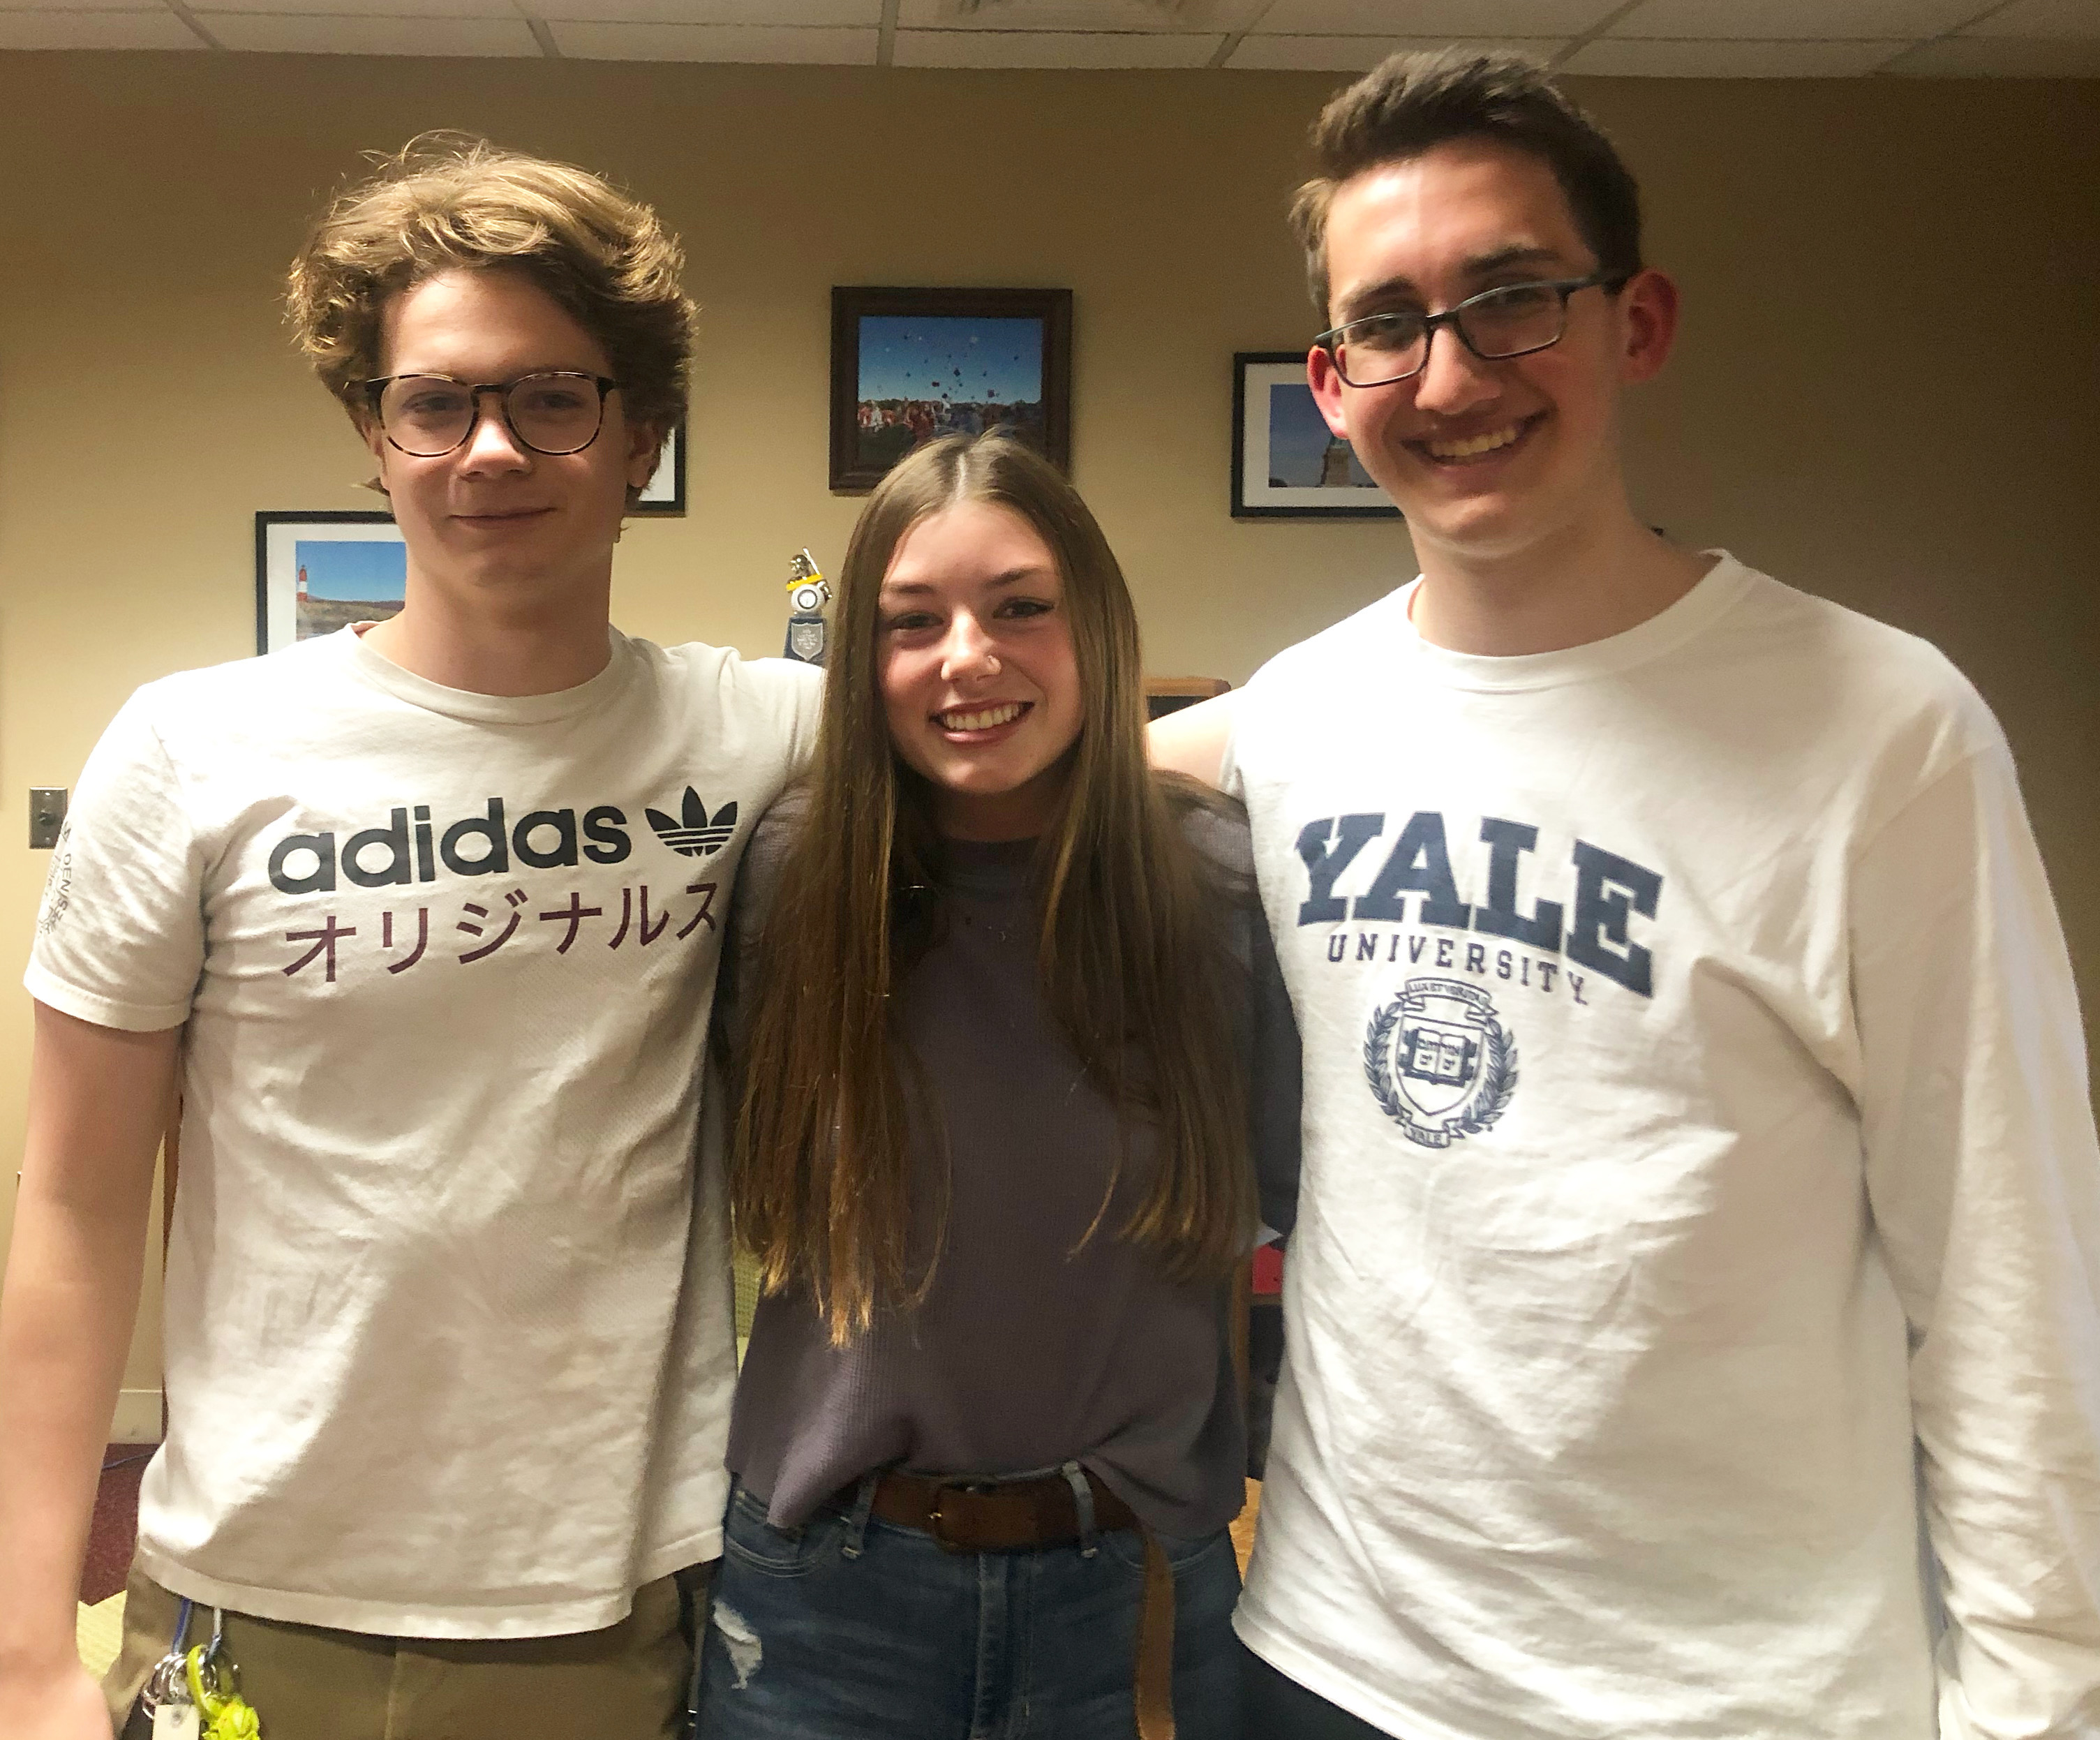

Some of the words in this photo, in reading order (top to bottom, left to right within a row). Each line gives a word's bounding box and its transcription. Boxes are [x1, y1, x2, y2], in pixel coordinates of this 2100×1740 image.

[268, 797, 632, 894] adidas
[281, 882, 717, 982] オリジナルス
[1294, 810, 1665, 999] YALE
[1327, 932, 1588, 1006] UNIVERSITY
